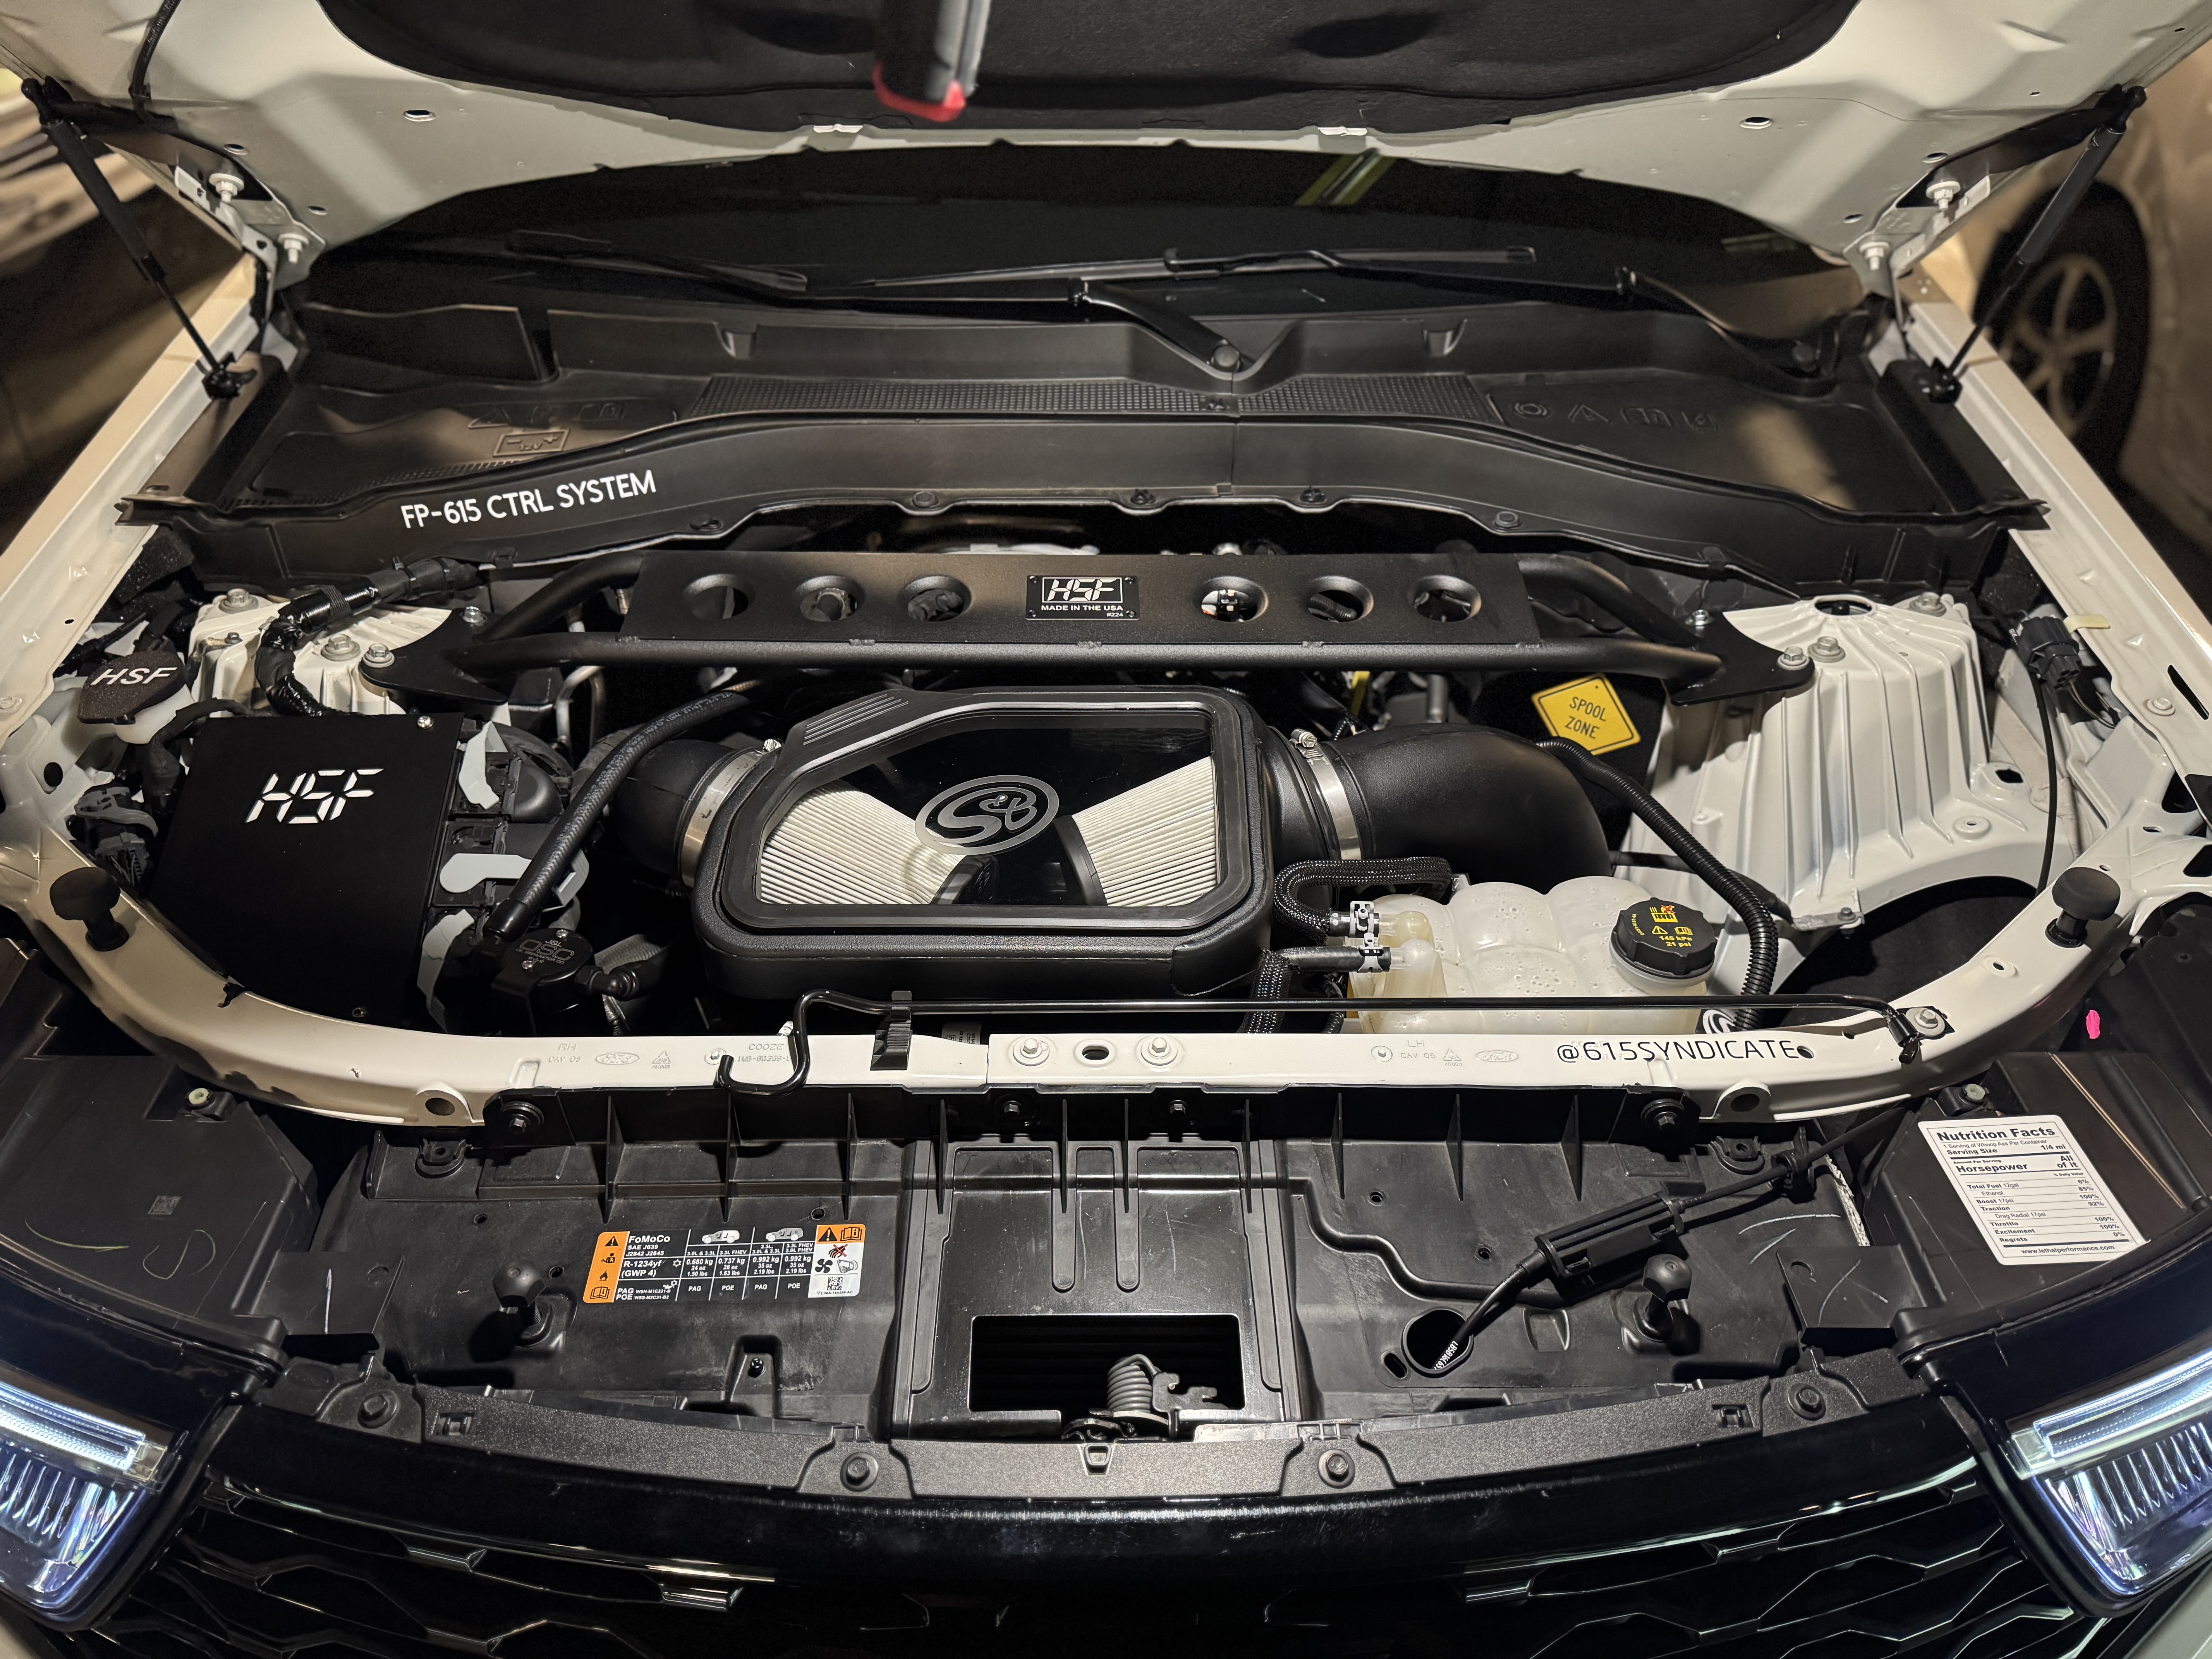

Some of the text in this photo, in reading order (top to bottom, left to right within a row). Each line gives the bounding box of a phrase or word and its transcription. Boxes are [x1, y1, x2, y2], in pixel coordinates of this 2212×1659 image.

[401, 470, 656, 529] FP-615 CTRL SYSTEM
[1047, 579, 1116, 601] HSF
[90, 667, 178, 685] HSF
[1570, 697, 1606, 722] SPOOL
[1565, 716, 1600, 739] ZONE
[245, 768, 384, 824] HSF
[520, 939, 574, 961] OSC
[558, 1043, 577, 1051] RH
[1557, 1040, 1799, 1063] @615SYNDICATE
[1936, 1127, 2055, 1141] Nutrition Facts
[1956, 1164, 2027, 1173] Horsepower
[628, 1234, 671, 1243] FoMoCo
[2021, 1245, 2115, 1254] www.lethalperformance.com
[621, 1269, 657, 1278] (GWP 4)
[623, 1260, 663, 1269] R-1234yf
